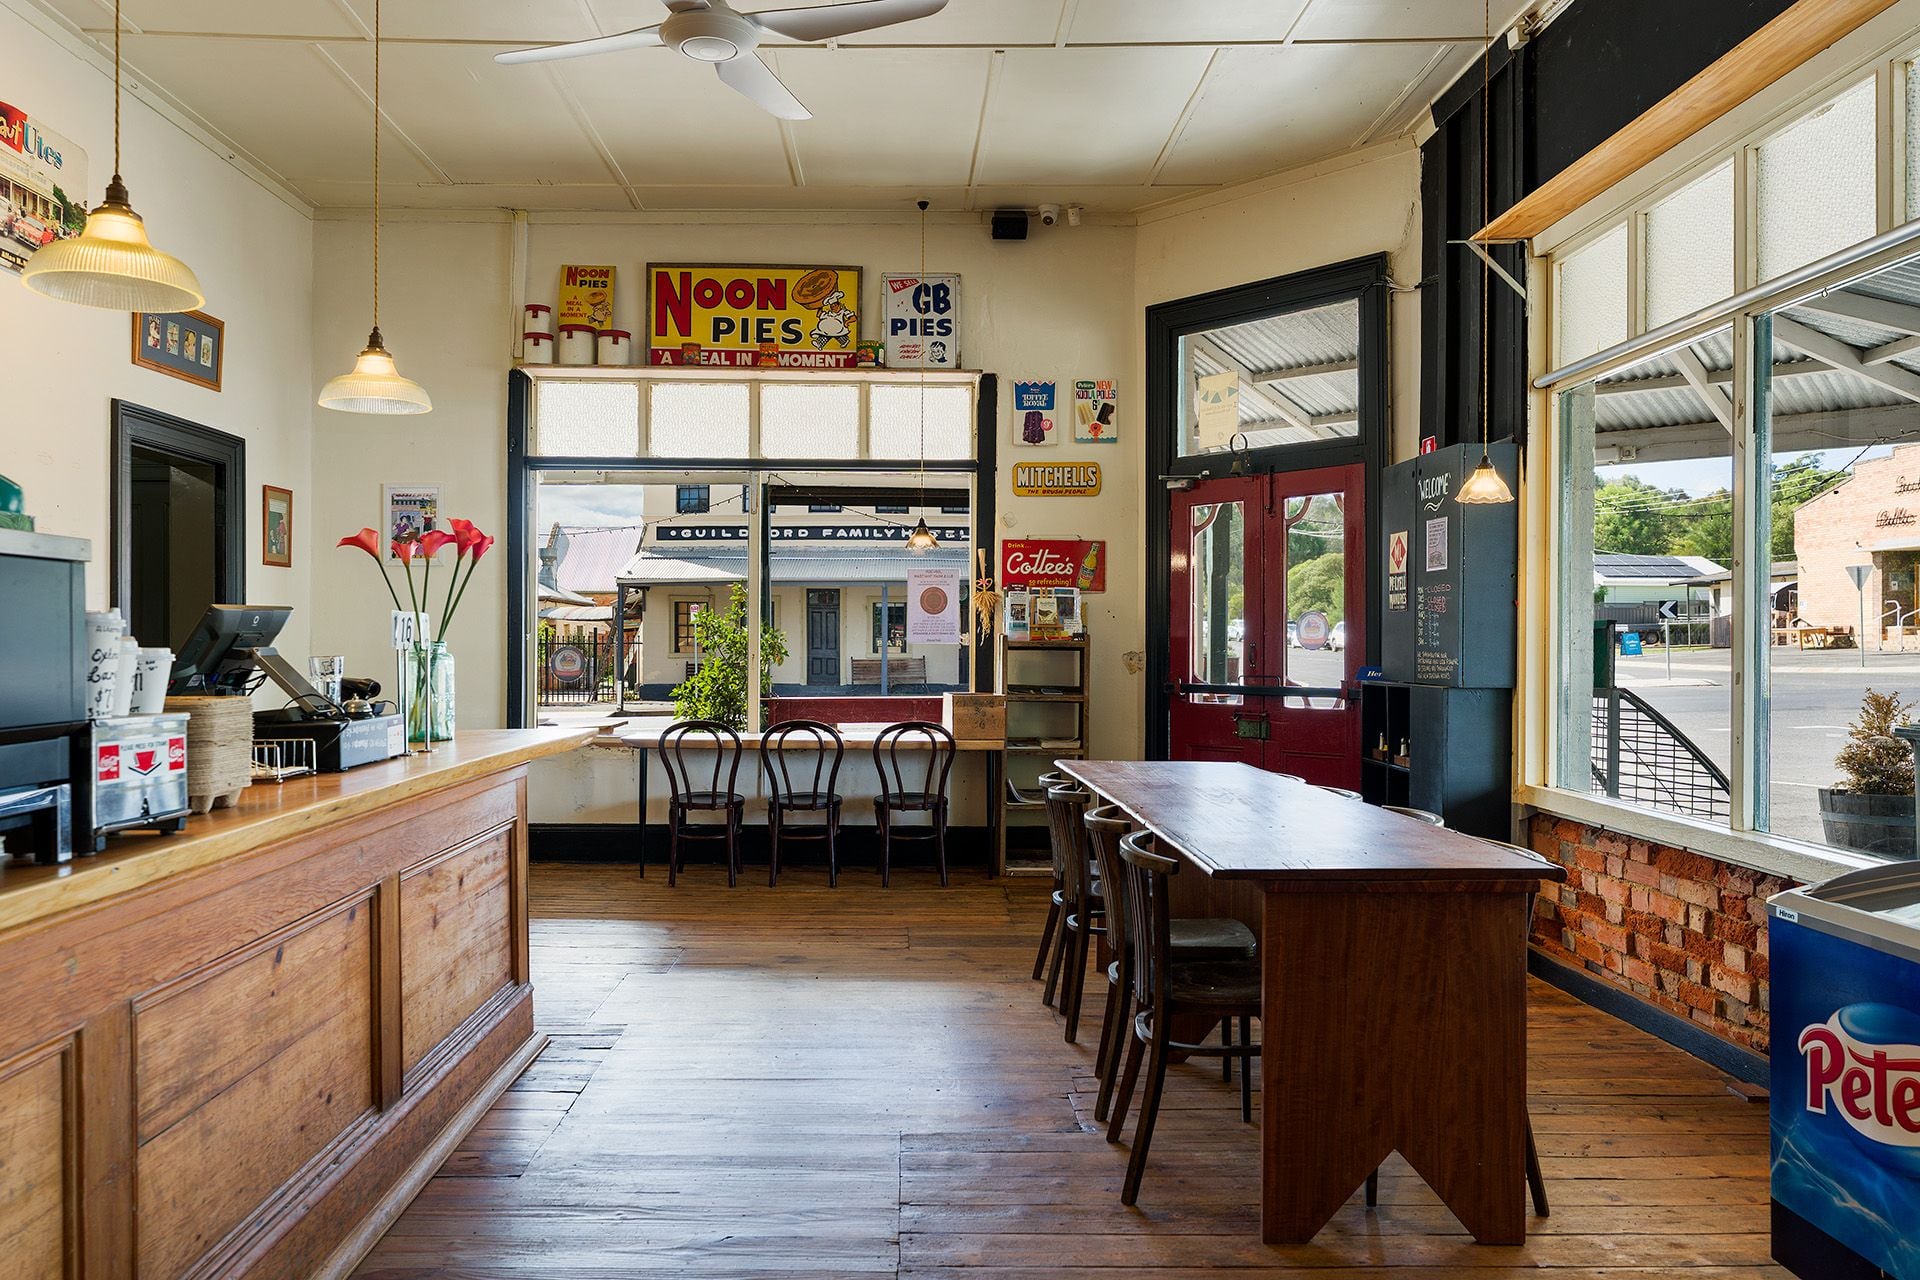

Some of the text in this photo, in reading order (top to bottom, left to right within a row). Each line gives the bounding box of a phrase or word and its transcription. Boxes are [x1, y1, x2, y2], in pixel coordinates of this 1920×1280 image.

[0, 115, 21, 145] aut
[22, 119, 64, 171] Utes
[566, 266, 610, 286] NOON
[579, 279, 608, 289] PIES
[890, 279, 903, 291] WE
[655, 271, 787, 337] NOON
[912, 282, 952, 315] GB
[711, 316, 803, 345] PIES
[890, 318, 953, 336] PIES
[700, 351, 730, 366] EAL
[736, 353, 753, 366] IN
[1096, 380, 1113, 390] NEW
[1096, 389, 1116, 400] POLES
[1016, 466, 1097, 488] MITCHELLS
[680, 528, 970, 539] GUILDORD FAMILY HTEL
[1006, 548, 1075, 575] Cottee's
[401, 616, 413, 643] 16
[1778, 908, 1796, 921] Hiron
[1799, 1026, 1920, 1134] Pete
